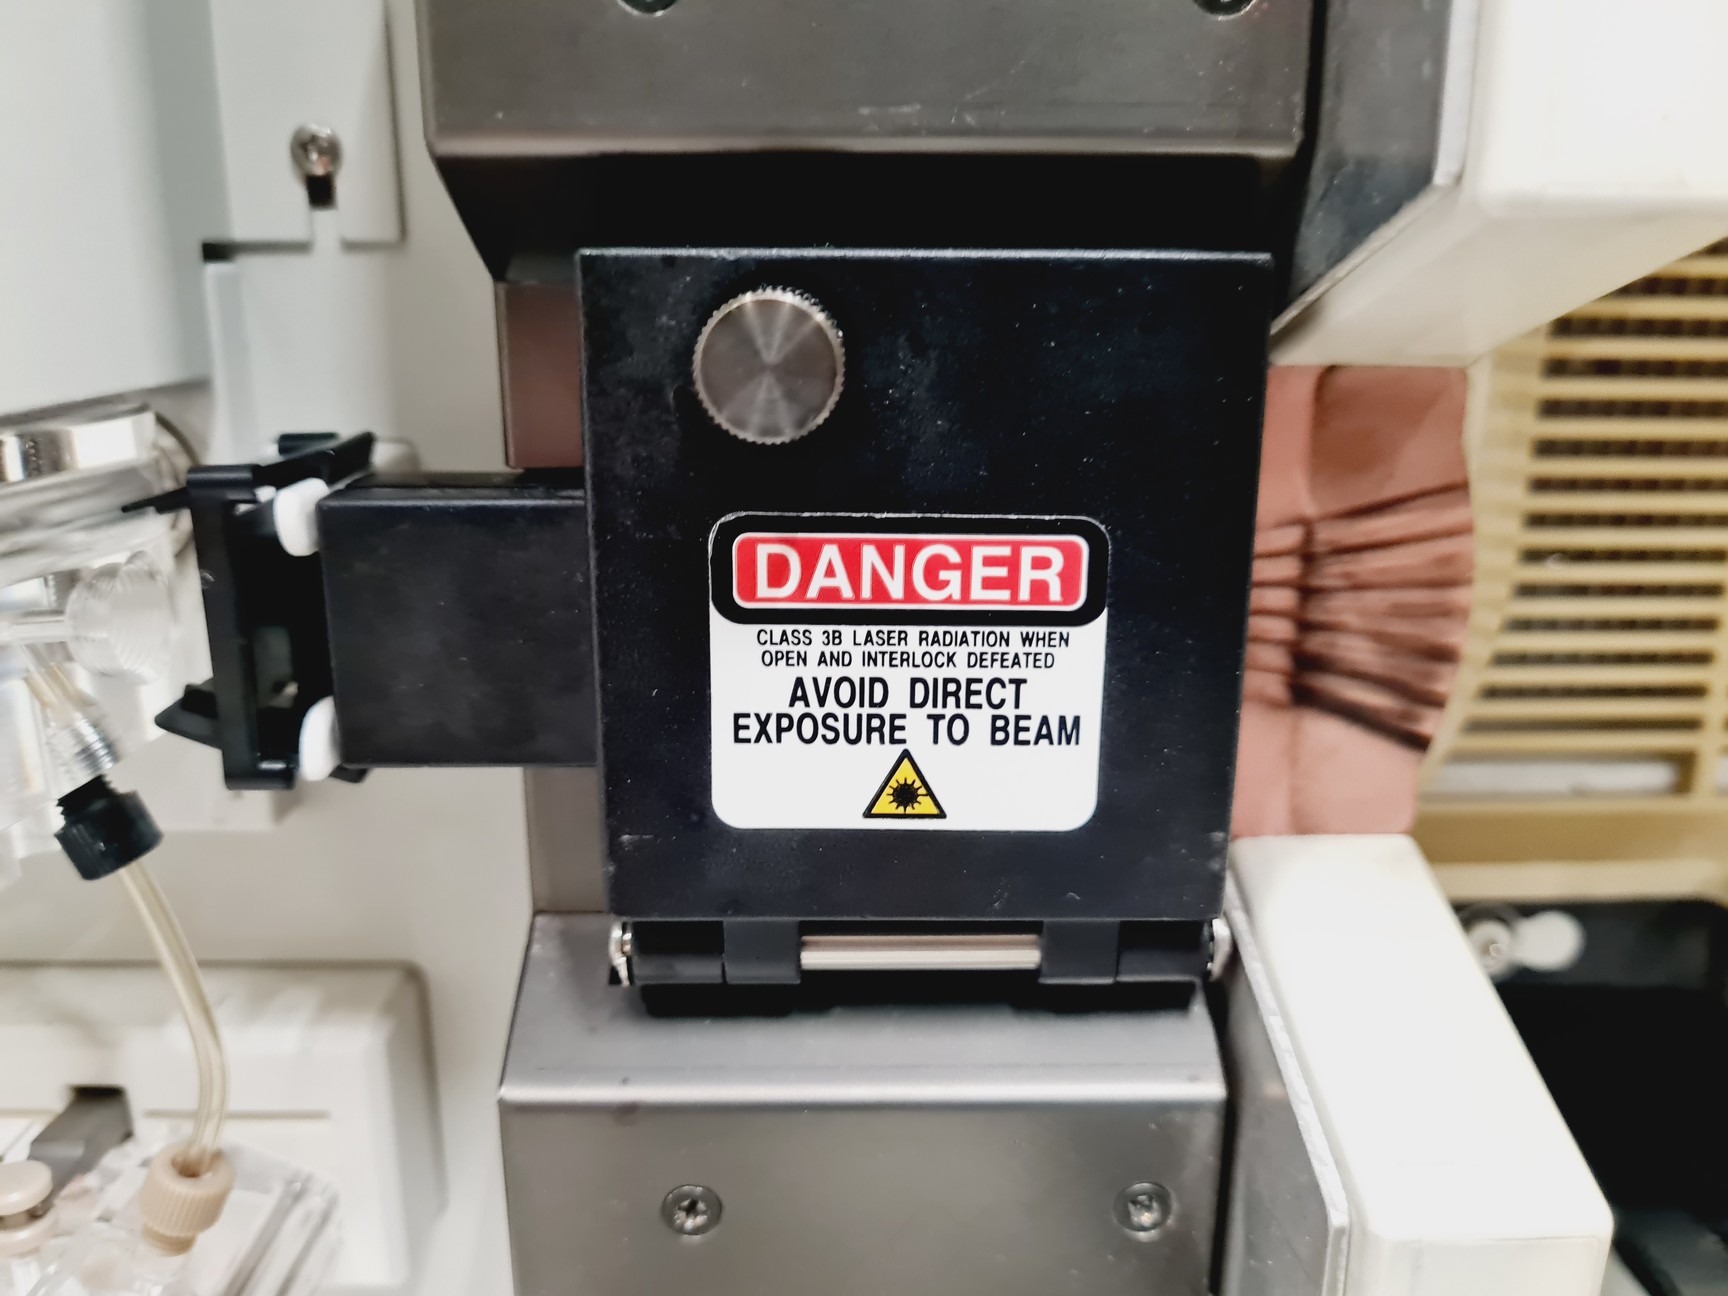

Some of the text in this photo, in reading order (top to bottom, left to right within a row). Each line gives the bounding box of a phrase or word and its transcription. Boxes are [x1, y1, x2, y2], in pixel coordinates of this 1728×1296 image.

[754, 543, 1065, 602] DANGER
[757, 629, 1069, 647] CLASS 3B LASER RADIATION WHEN
[762, 650, 1054, 668] OPEN AND INTERLOCK DEFEATED
[789, 676, 1027, 709] AVOID DIRECT
[734, 712, 1080, 746] EXPOSURE TO BEAM
